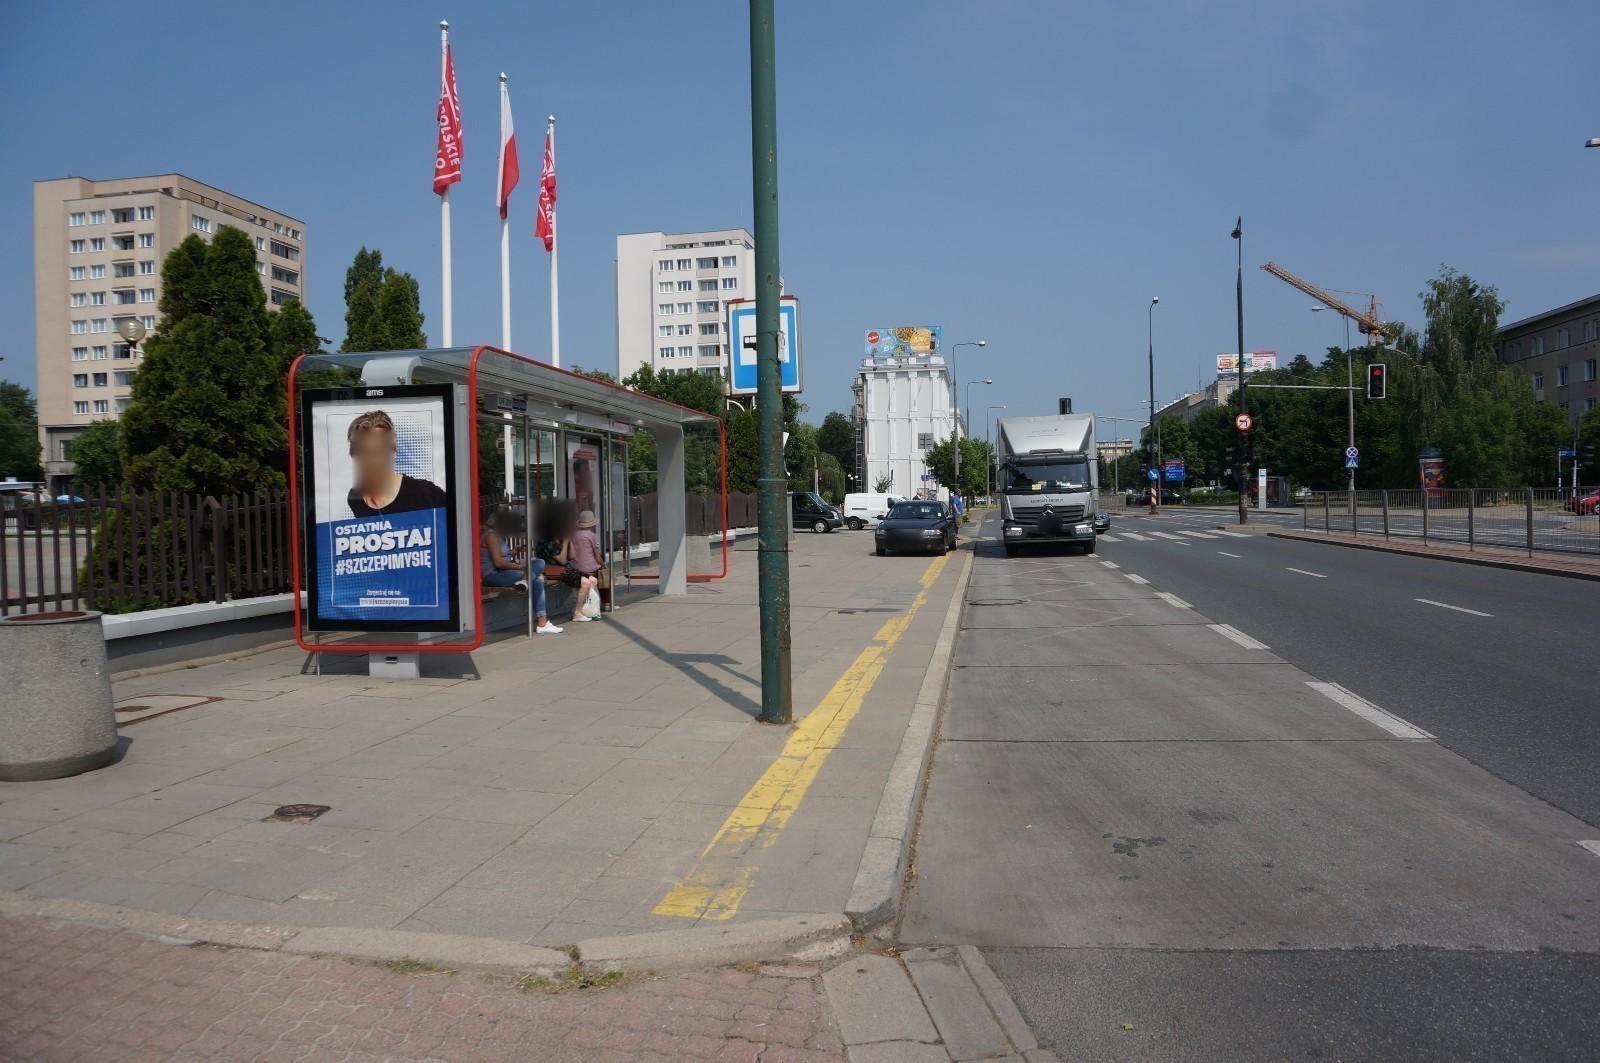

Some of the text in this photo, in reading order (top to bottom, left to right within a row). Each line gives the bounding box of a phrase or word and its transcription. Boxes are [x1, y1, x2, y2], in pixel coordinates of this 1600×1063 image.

[366, 389, 384, 397] ams
[335, 520, 393, 536] OSTATNIA
[335, 527, 432, 556] PROSTA!
[335, 549, 432, 576] #SZCZEPIMYSIĘ
